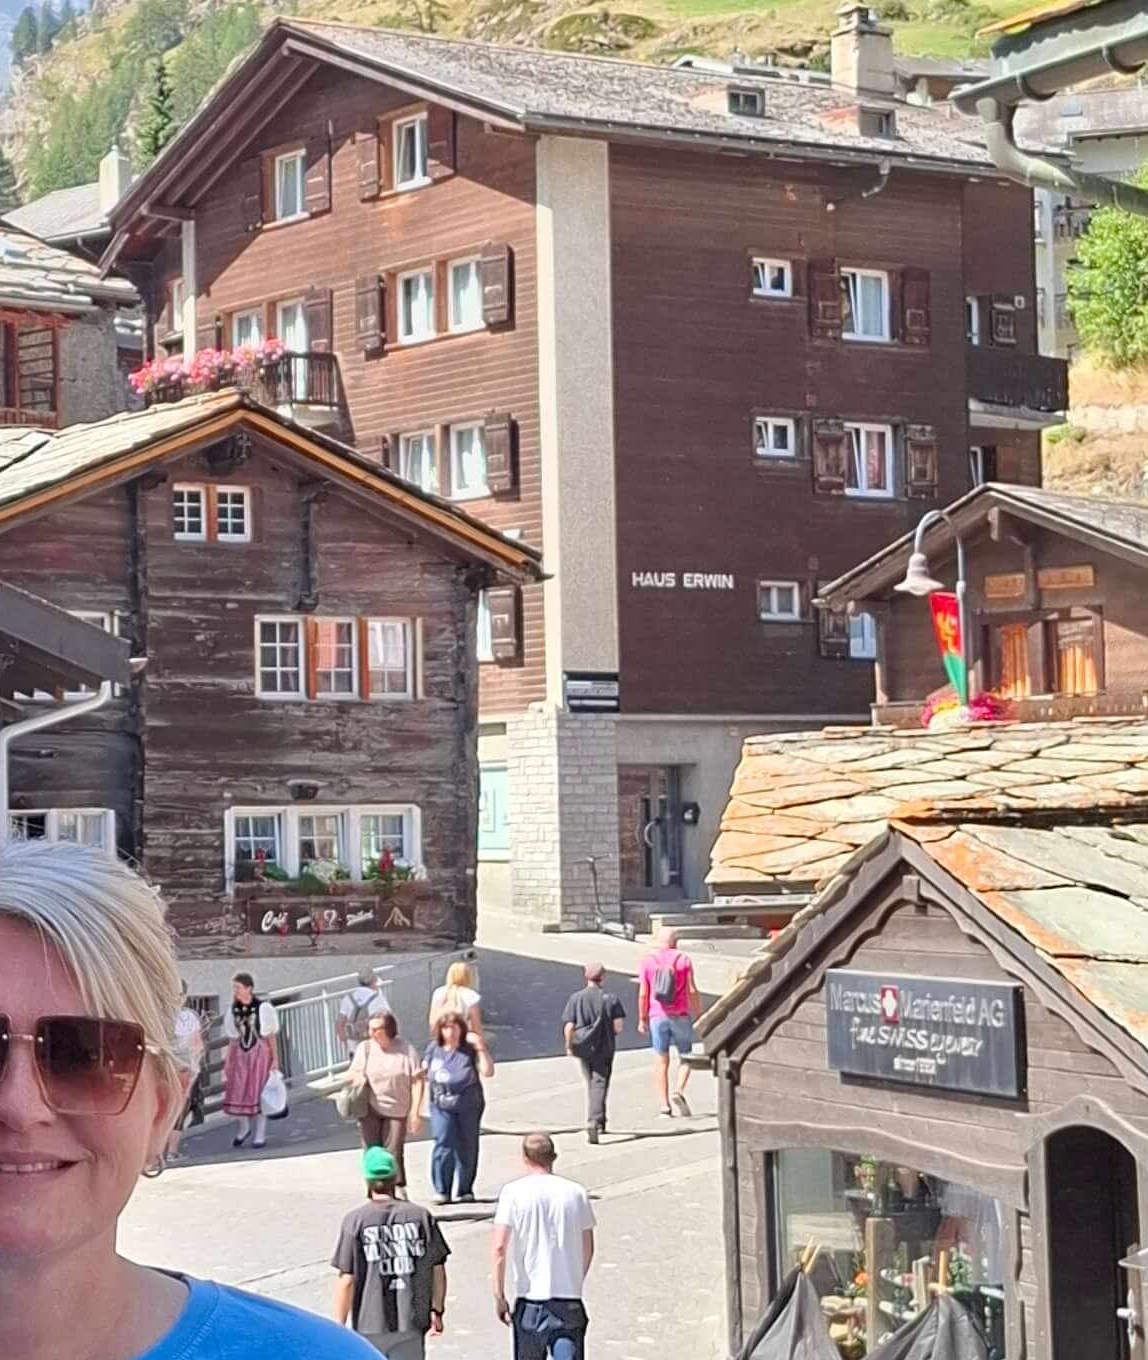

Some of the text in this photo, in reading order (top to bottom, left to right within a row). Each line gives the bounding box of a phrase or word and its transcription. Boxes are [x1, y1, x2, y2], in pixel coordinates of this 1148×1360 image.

[632, 571, 734, 589] HAUS ERWIN
[830, 983, 1004, 1028] Marcus Marienfeld AG
